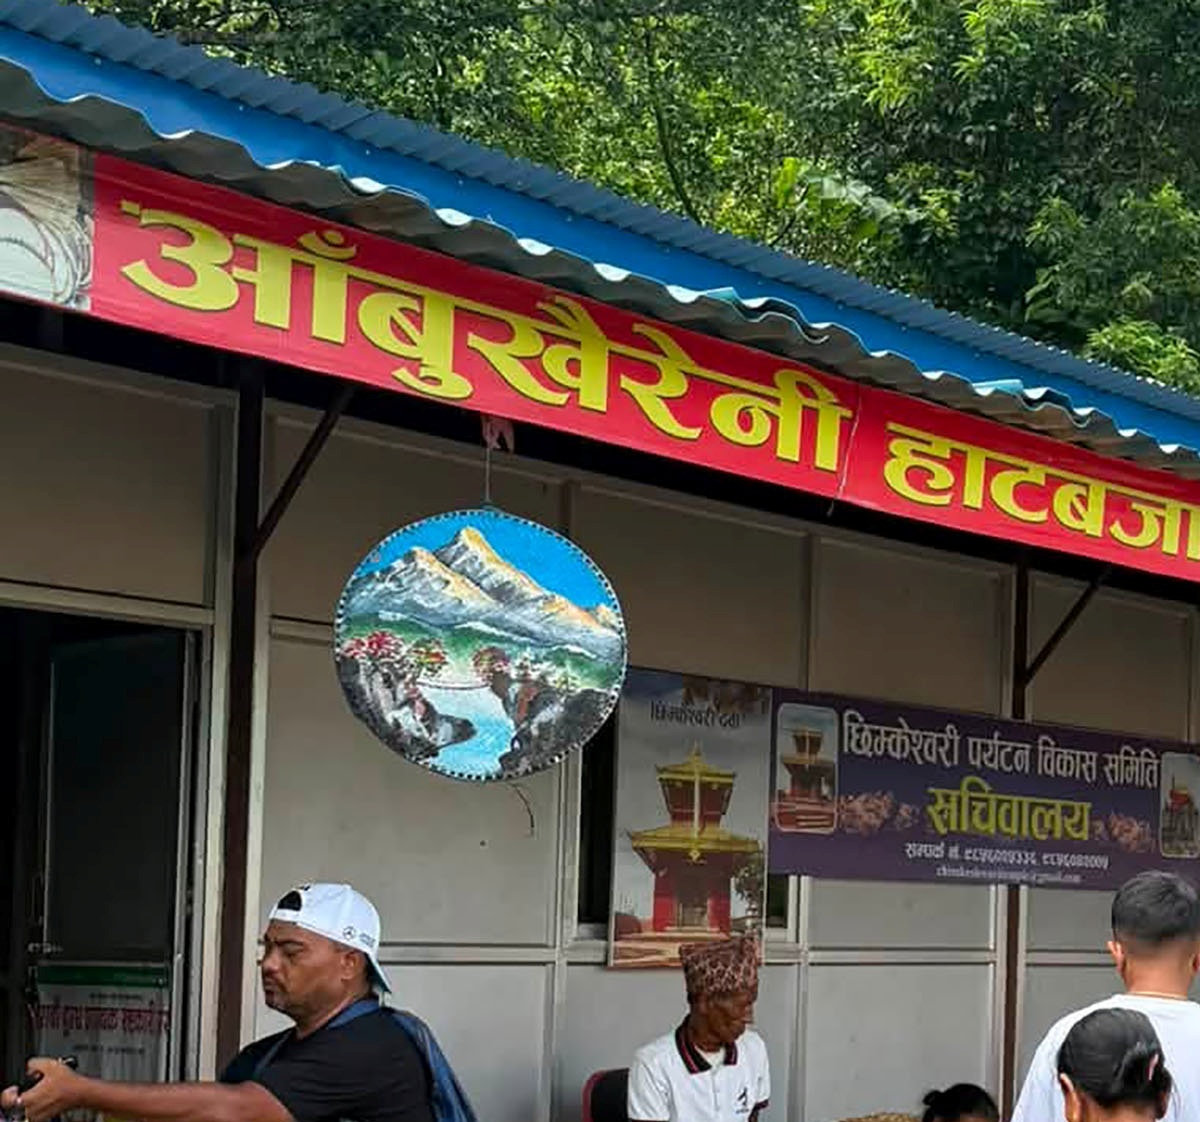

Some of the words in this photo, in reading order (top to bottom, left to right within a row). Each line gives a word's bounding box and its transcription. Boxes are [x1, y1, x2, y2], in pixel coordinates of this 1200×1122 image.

[120, 200, 853, 472] आँबुखैरेनी
[843, 709, 960, 767] छिम्केश्वरी
[1037, 734, 1099, 783] विकास
[1102, 745, 1161, 788] समिति
[926, 775, 1092, 841] सचिवालय
